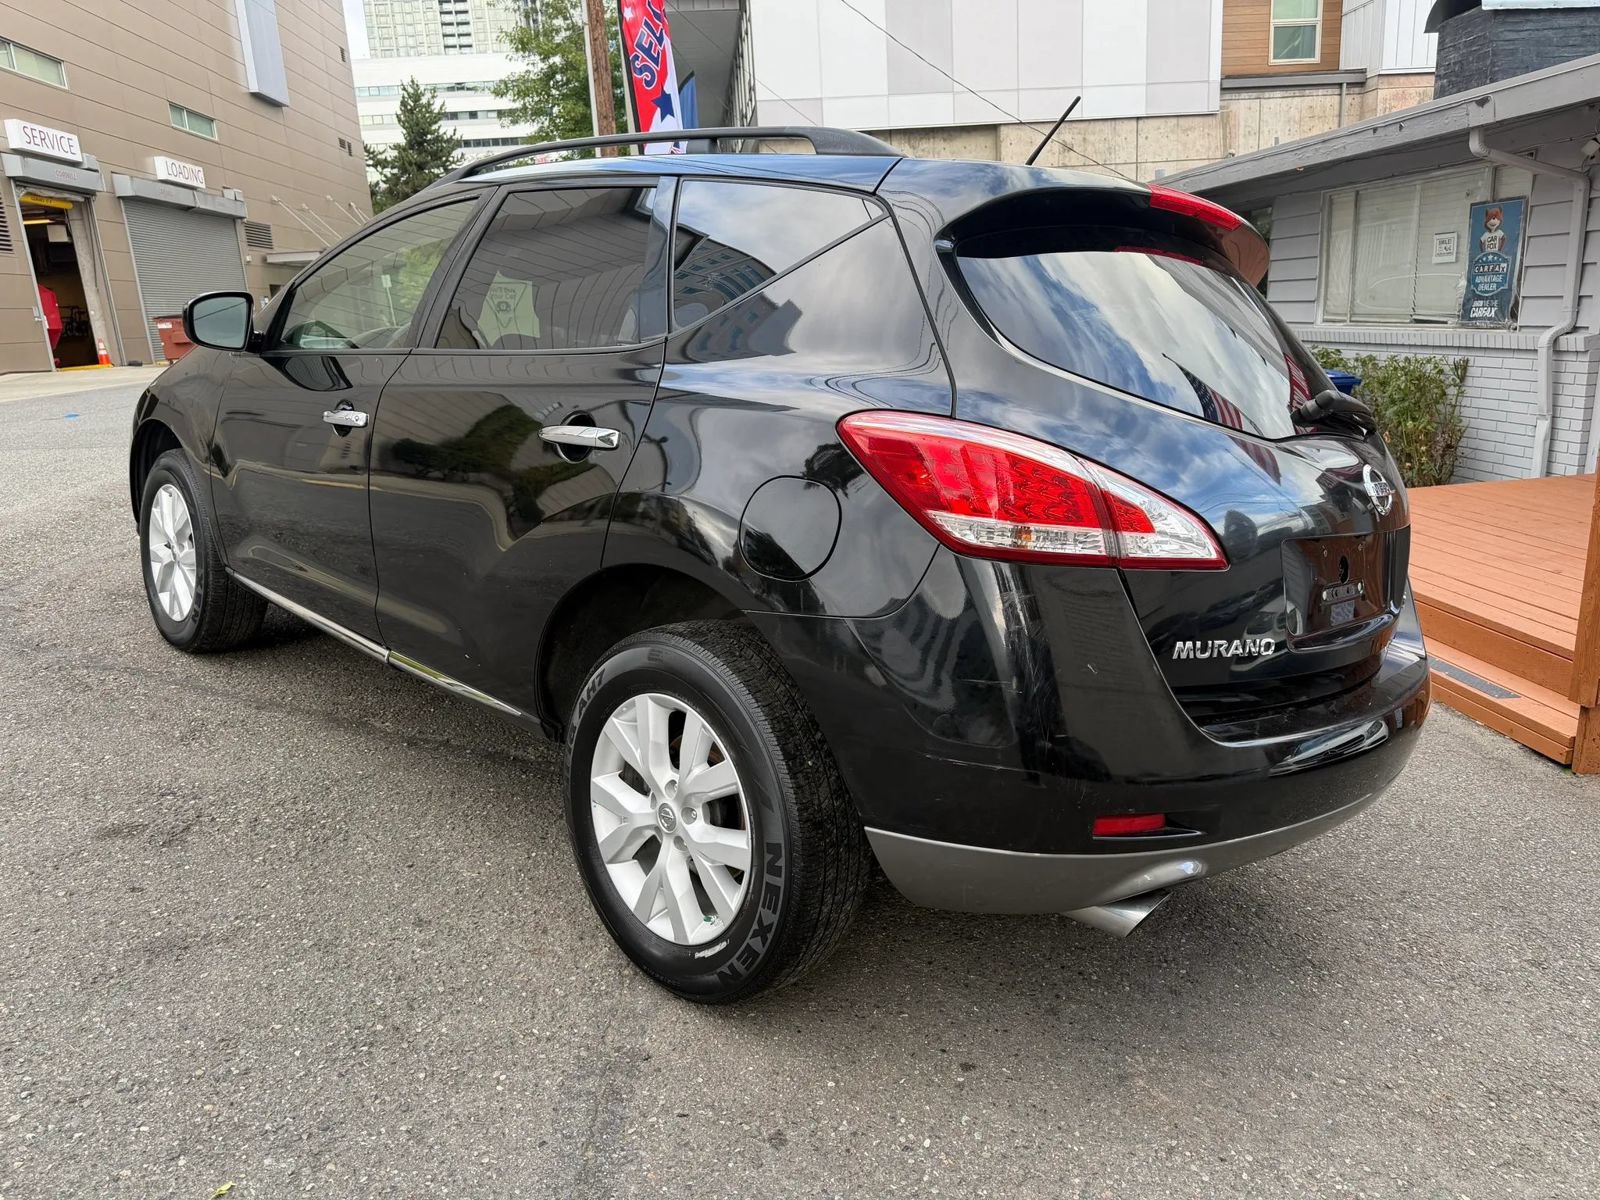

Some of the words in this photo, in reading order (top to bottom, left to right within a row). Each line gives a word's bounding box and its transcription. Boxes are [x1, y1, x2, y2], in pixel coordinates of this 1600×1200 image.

[22, 125, 77, 155] SERVICE
[165, 159, 204, 184] LOADING
[1486, 235, 1498, 243] CAR
[1475, 263, 1507, 273] CARFAX
[1475, 274, 1503, 283] ADVANTAGE
[1477, 283, 1497, 291] DEALER
[1470, 306, 1498, 318] CARFAX
[1172, 638, 1275, 660] MURANO
[578, 667, 606, 719] AH7
[717, 842, 783, 985] NEXEN
